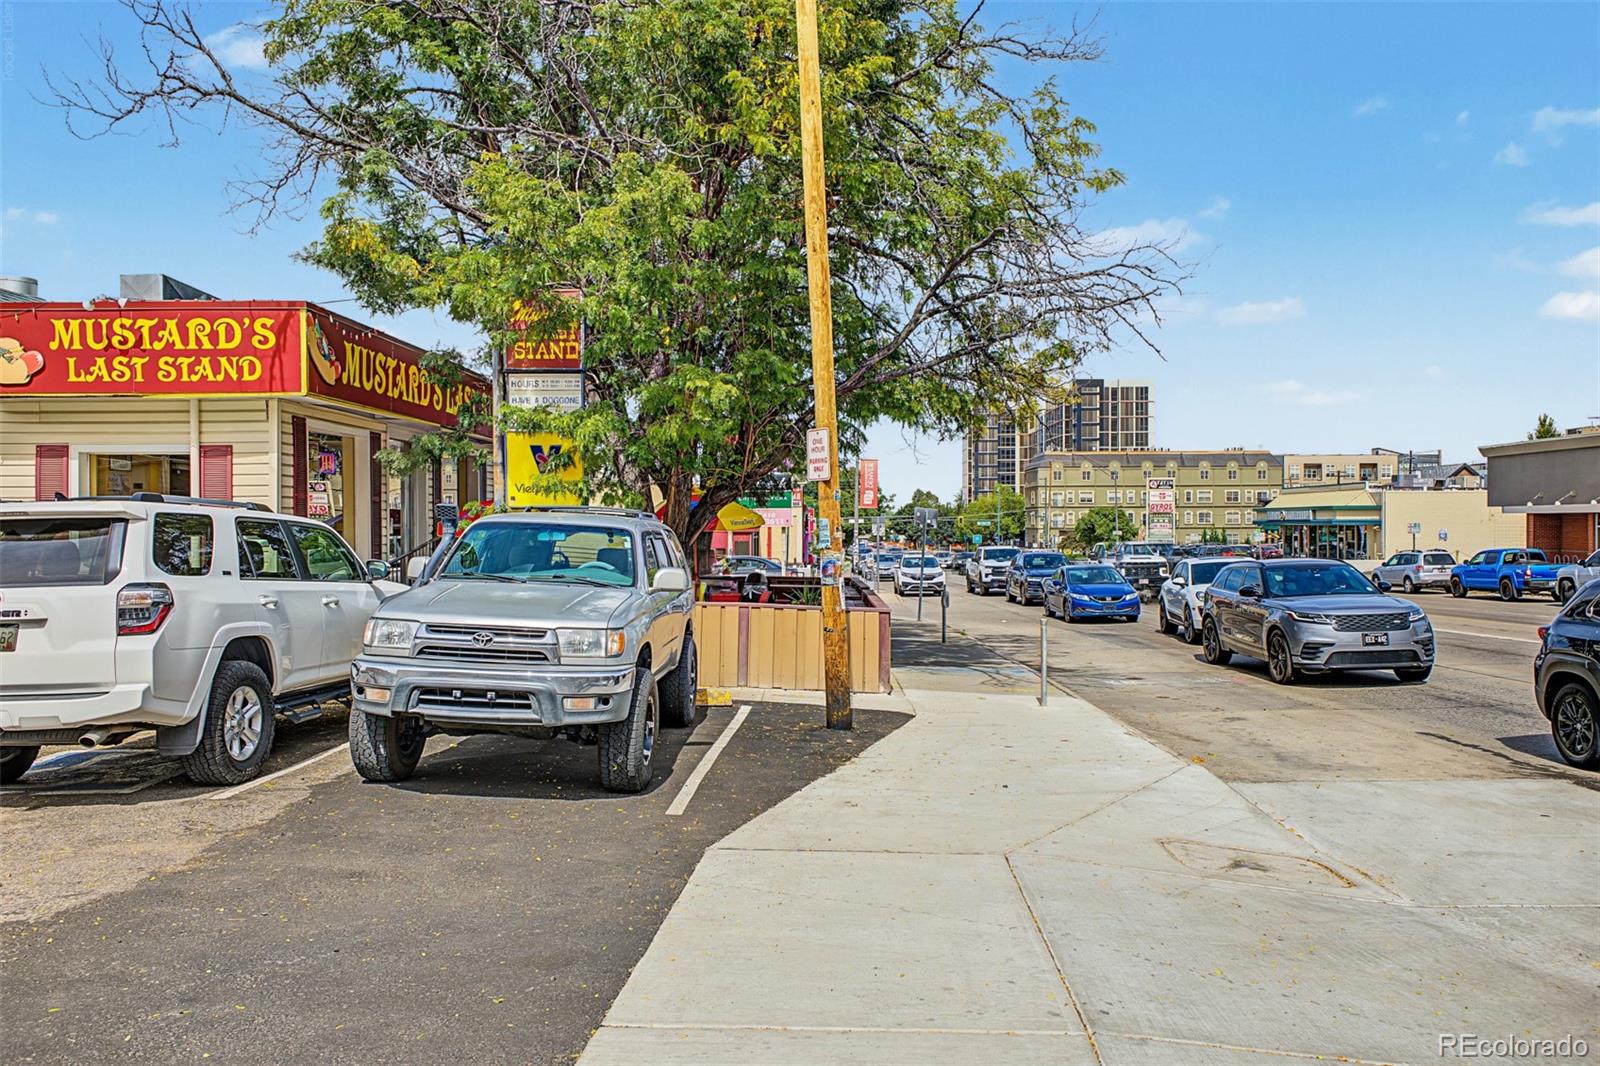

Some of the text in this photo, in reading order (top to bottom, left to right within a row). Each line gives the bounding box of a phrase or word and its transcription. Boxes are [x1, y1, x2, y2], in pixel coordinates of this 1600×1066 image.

[49, 317, 277, 352] MUSTARD'S
[514, 341, 579, 360] STAND
[66, 355, 263, 384] LAST STAND
[341, 340, 443, 411] MUSTARDS
[510, 380, 540, 389] HOURS
[511, 396, 530, 405] HAVE
[810, 457, 828, 465] PARKING
[813, 465, 824, 473] ONLY
